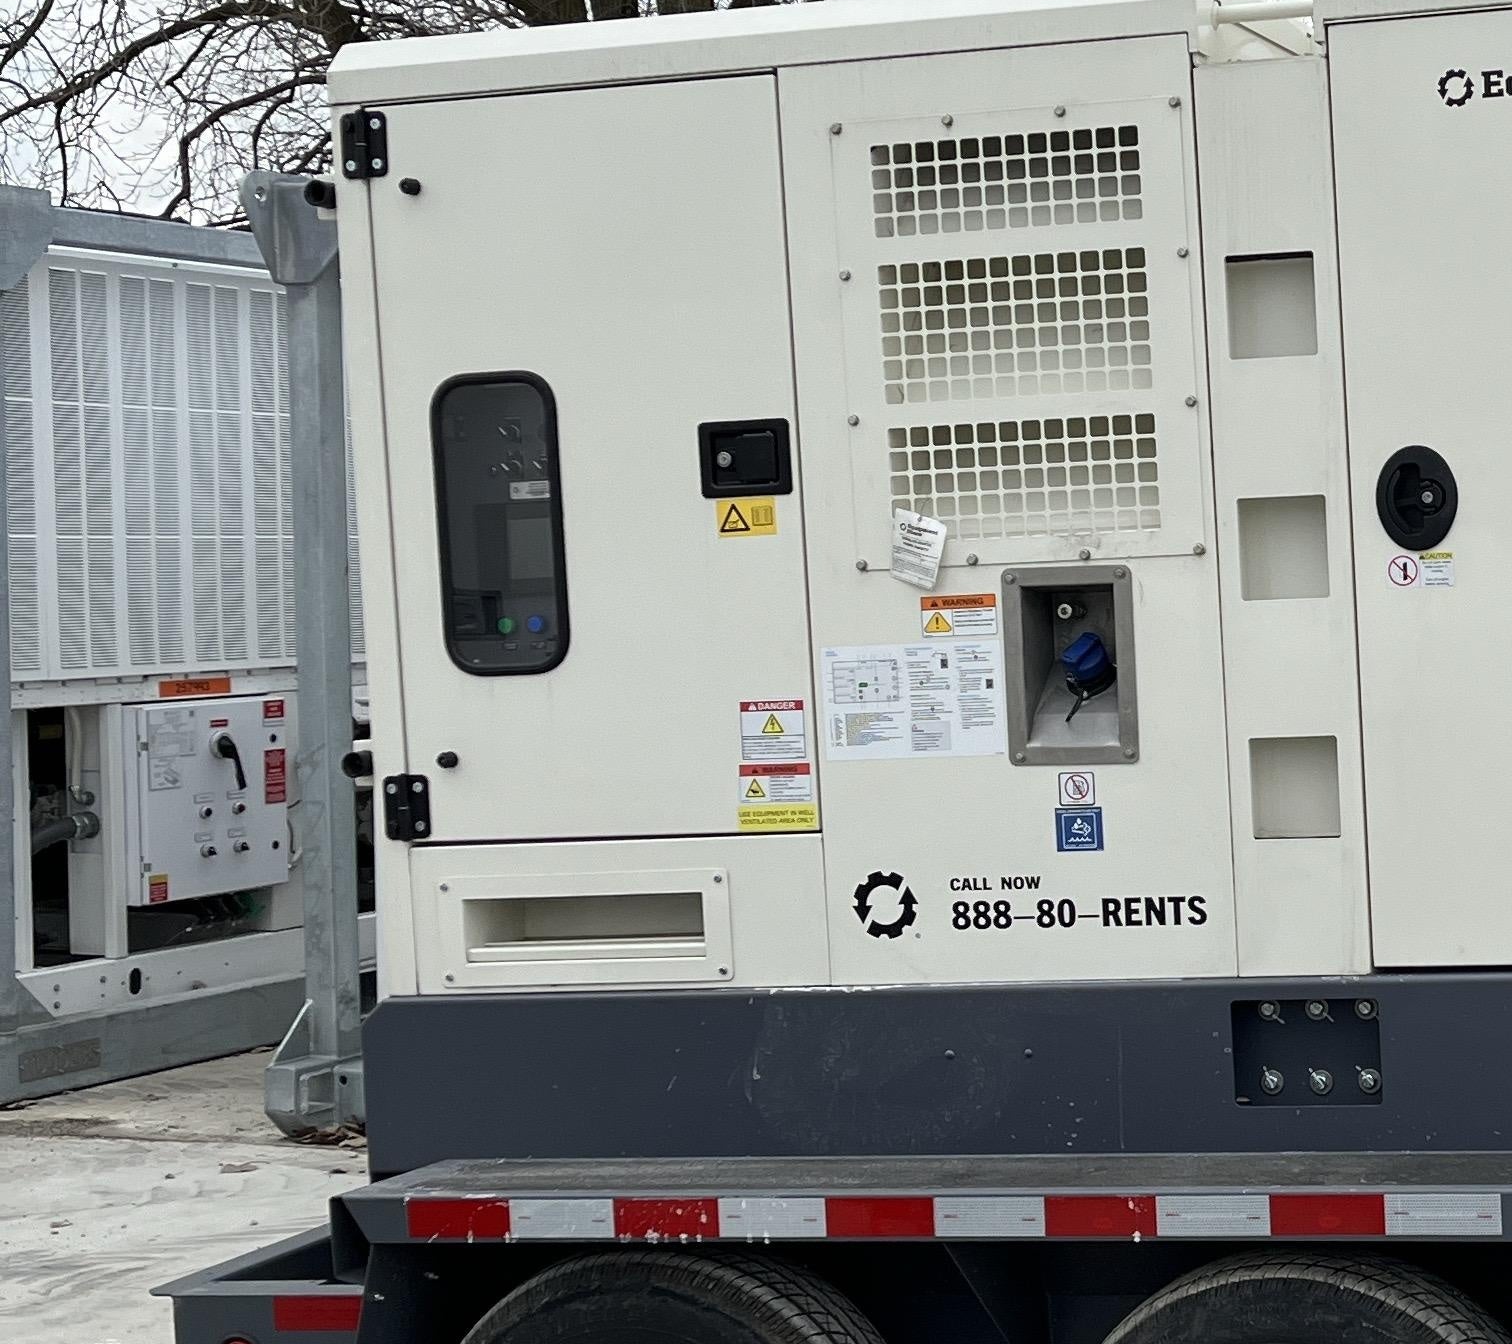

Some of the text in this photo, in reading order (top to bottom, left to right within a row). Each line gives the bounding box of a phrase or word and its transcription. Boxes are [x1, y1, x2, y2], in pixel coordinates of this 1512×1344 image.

[941, 597, 984, 607] WARNING
[757, 702, 796, 711] DANGER
[950, 875, 1041, 891] CALL NOW
